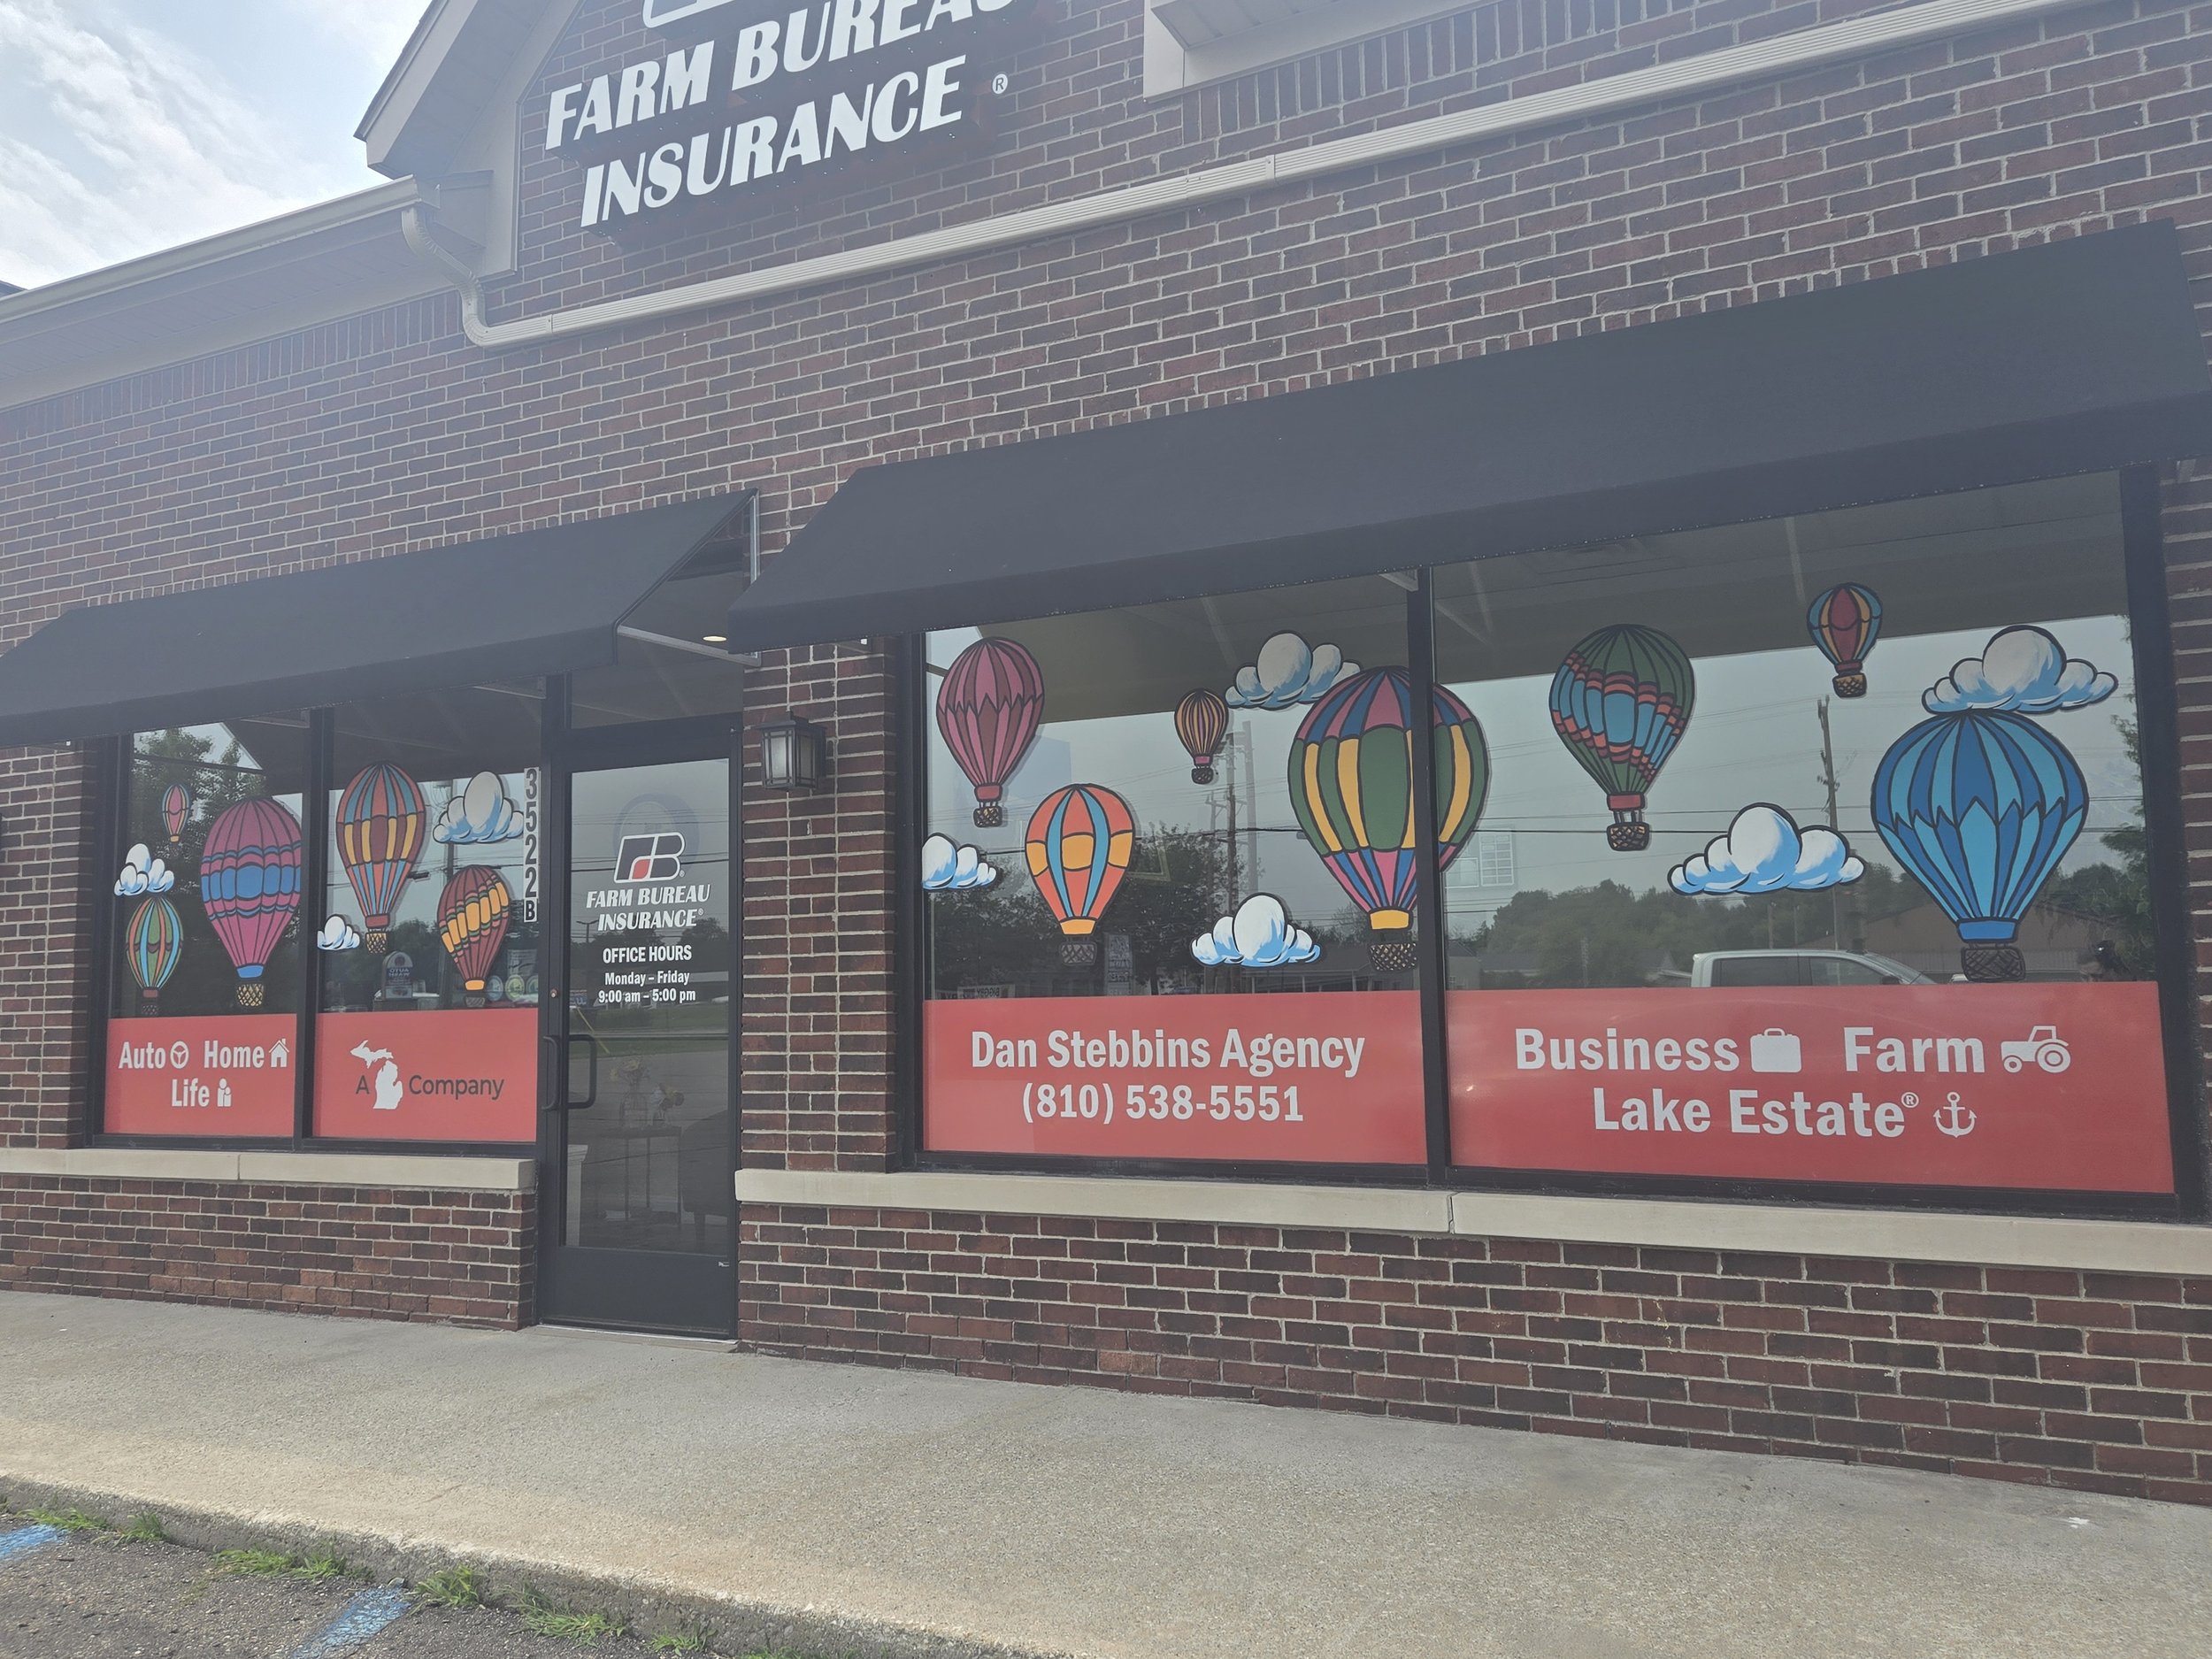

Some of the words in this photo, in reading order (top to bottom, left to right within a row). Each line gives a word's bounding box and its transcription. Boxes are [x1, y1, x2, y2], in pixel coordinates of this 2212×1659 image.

[545, 41, 714, 150] FARM
[731, 0, 1012, 90] BURE
[580, 54, 966, 228] INSURANCE
[586, 889, 634, 909] FARM
[637, 884, 711, 906] BUREAU
[603, 947, 646, 964] OFFICE
[649, 944, 693, 962] HOURS
[604, 972, 646, 987] Monday
[657, 970, 690, 986] Friday
[598, 990, 622, 1003] 9:00
[625, 992, 641, 1002] am
[652, 988, 677, 1002] 5:00
[679, 990, 696, 1003] pm
[118, 1041, 166, 1069] Auto
[204, 1040, 265, 1068] Home
[972, 1031, 1038, 1068] Dan
[1047, 1028, 1211, 1069] Stebbins
[1220, 1028, 1366, 1078] Agency
[1515, 1027, 1740, 1073] Business
[1844, 1025, 1985, 1074] Farm
[171, 1078, 211, 1107] Life
[356, 1075, 370, 1094] A
[409, 1074, 504, 1100] Company
[1023, 1082, 1115, 1125] (810)
[1125, 1084, 1304, 1122] 538-5551
[1594, 1087, 1711, 1133] Lake
